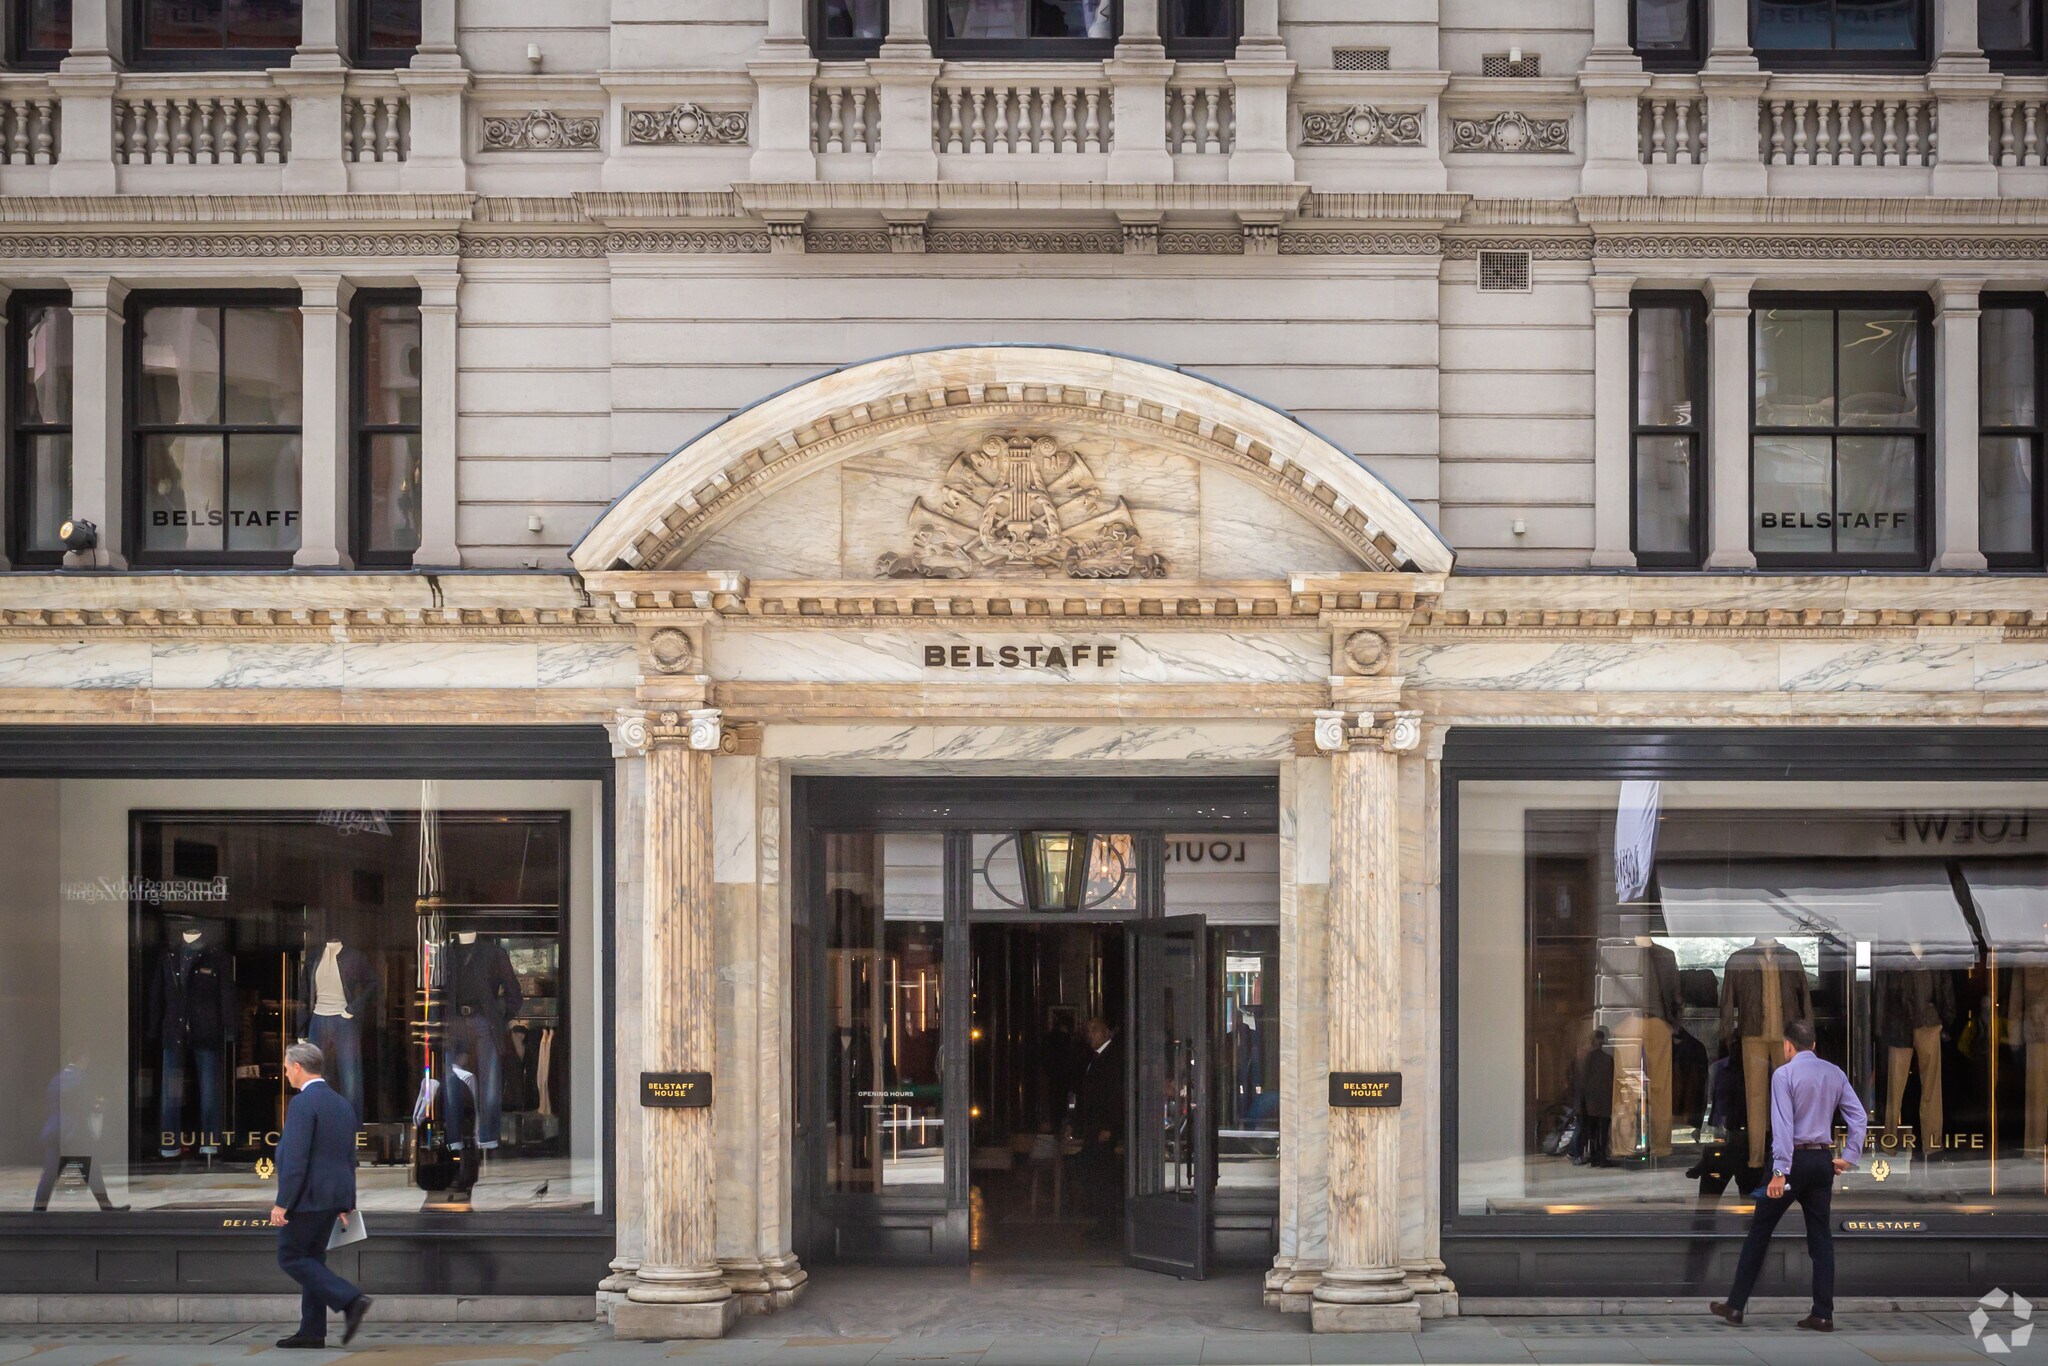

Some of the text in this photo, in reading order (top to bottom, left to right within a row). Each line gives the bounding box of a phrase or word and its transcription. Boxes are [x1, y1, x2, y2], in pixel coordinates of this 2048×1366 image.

[152, 510, 299, 527] BELSTAFF
[1761, 512, 1907, 529] BELSTAFF
[924, 645, 1117, 668] BELSTAFF
[161, 1131, 281, 1146] BUILT FO
[1864, 1133, 1916, 1148] FOR
[1930, 1133, 1984, 1148] LIFE
[1848, 1221, 1921, 1230] BELSTAFF
